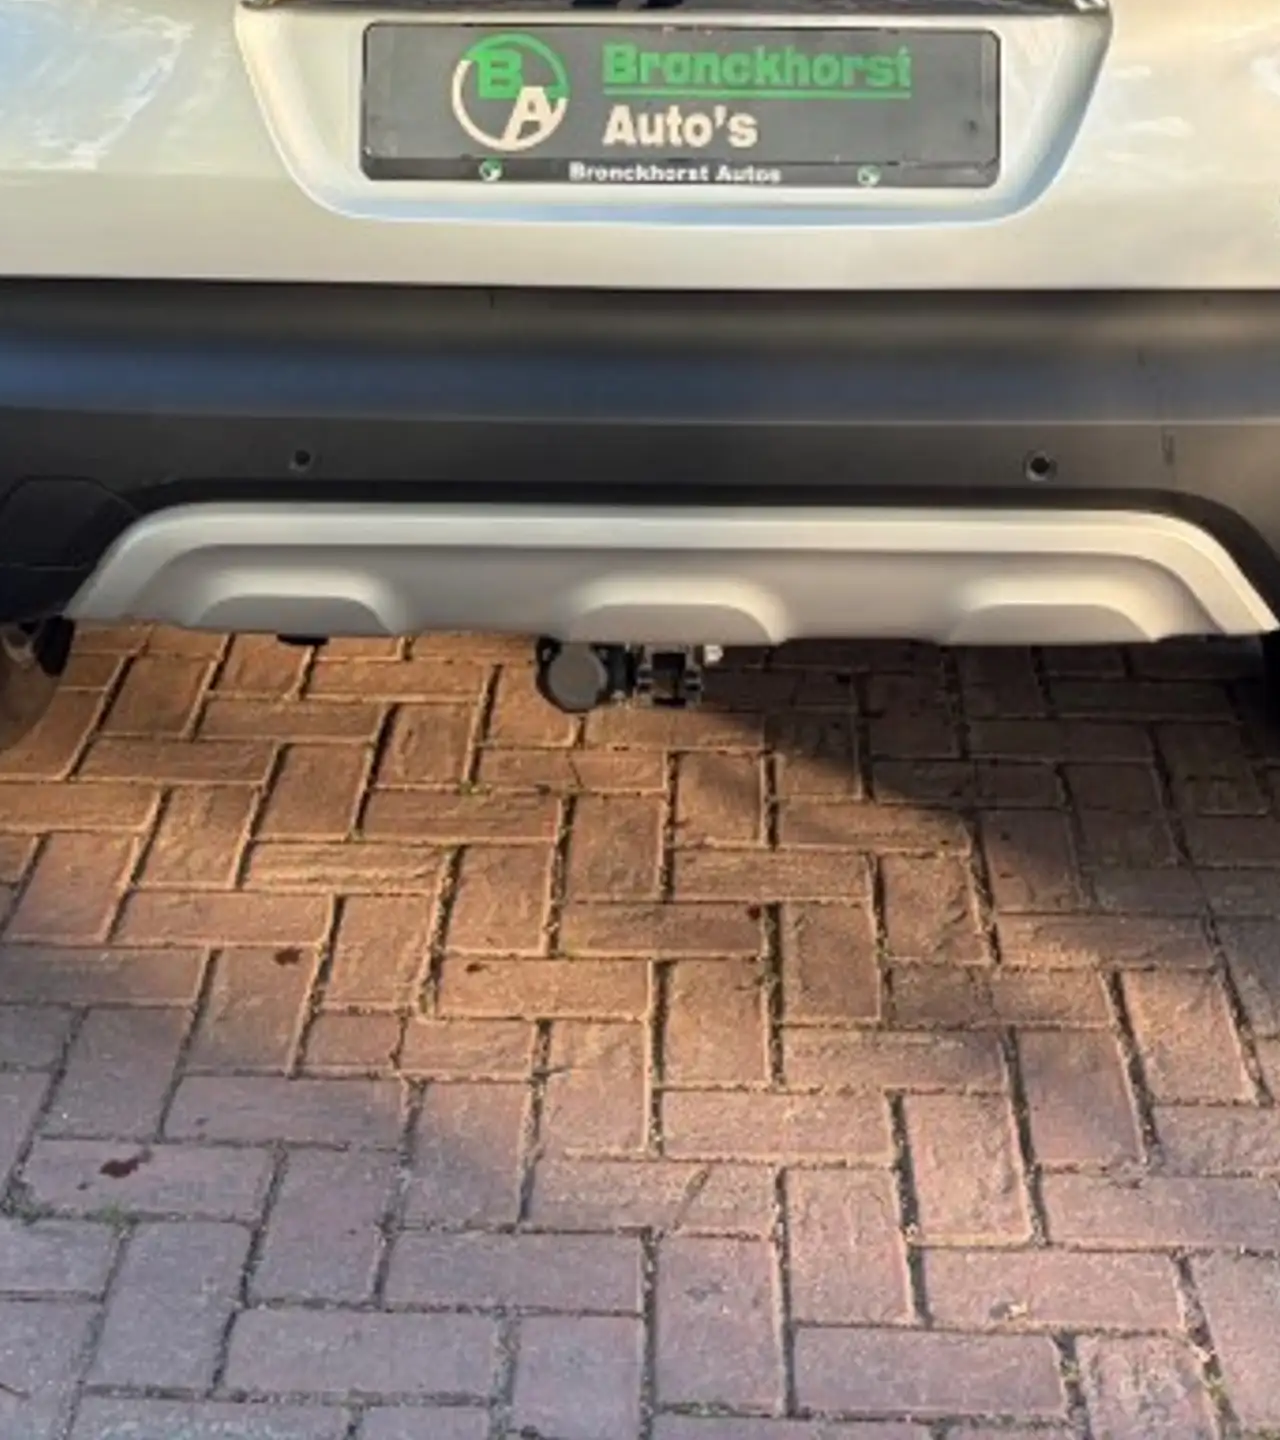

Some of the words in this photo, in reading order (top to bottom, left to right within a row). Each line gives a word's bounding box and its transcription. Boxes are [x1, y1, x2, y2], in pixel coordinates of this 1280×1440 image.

[602, 44, 912, 89] Bronckhorst
[602, 105, 759, 148] Auto's
[568, 161, 710, 183] Bronckhorst
[715, 163, 782, 184] Autos
